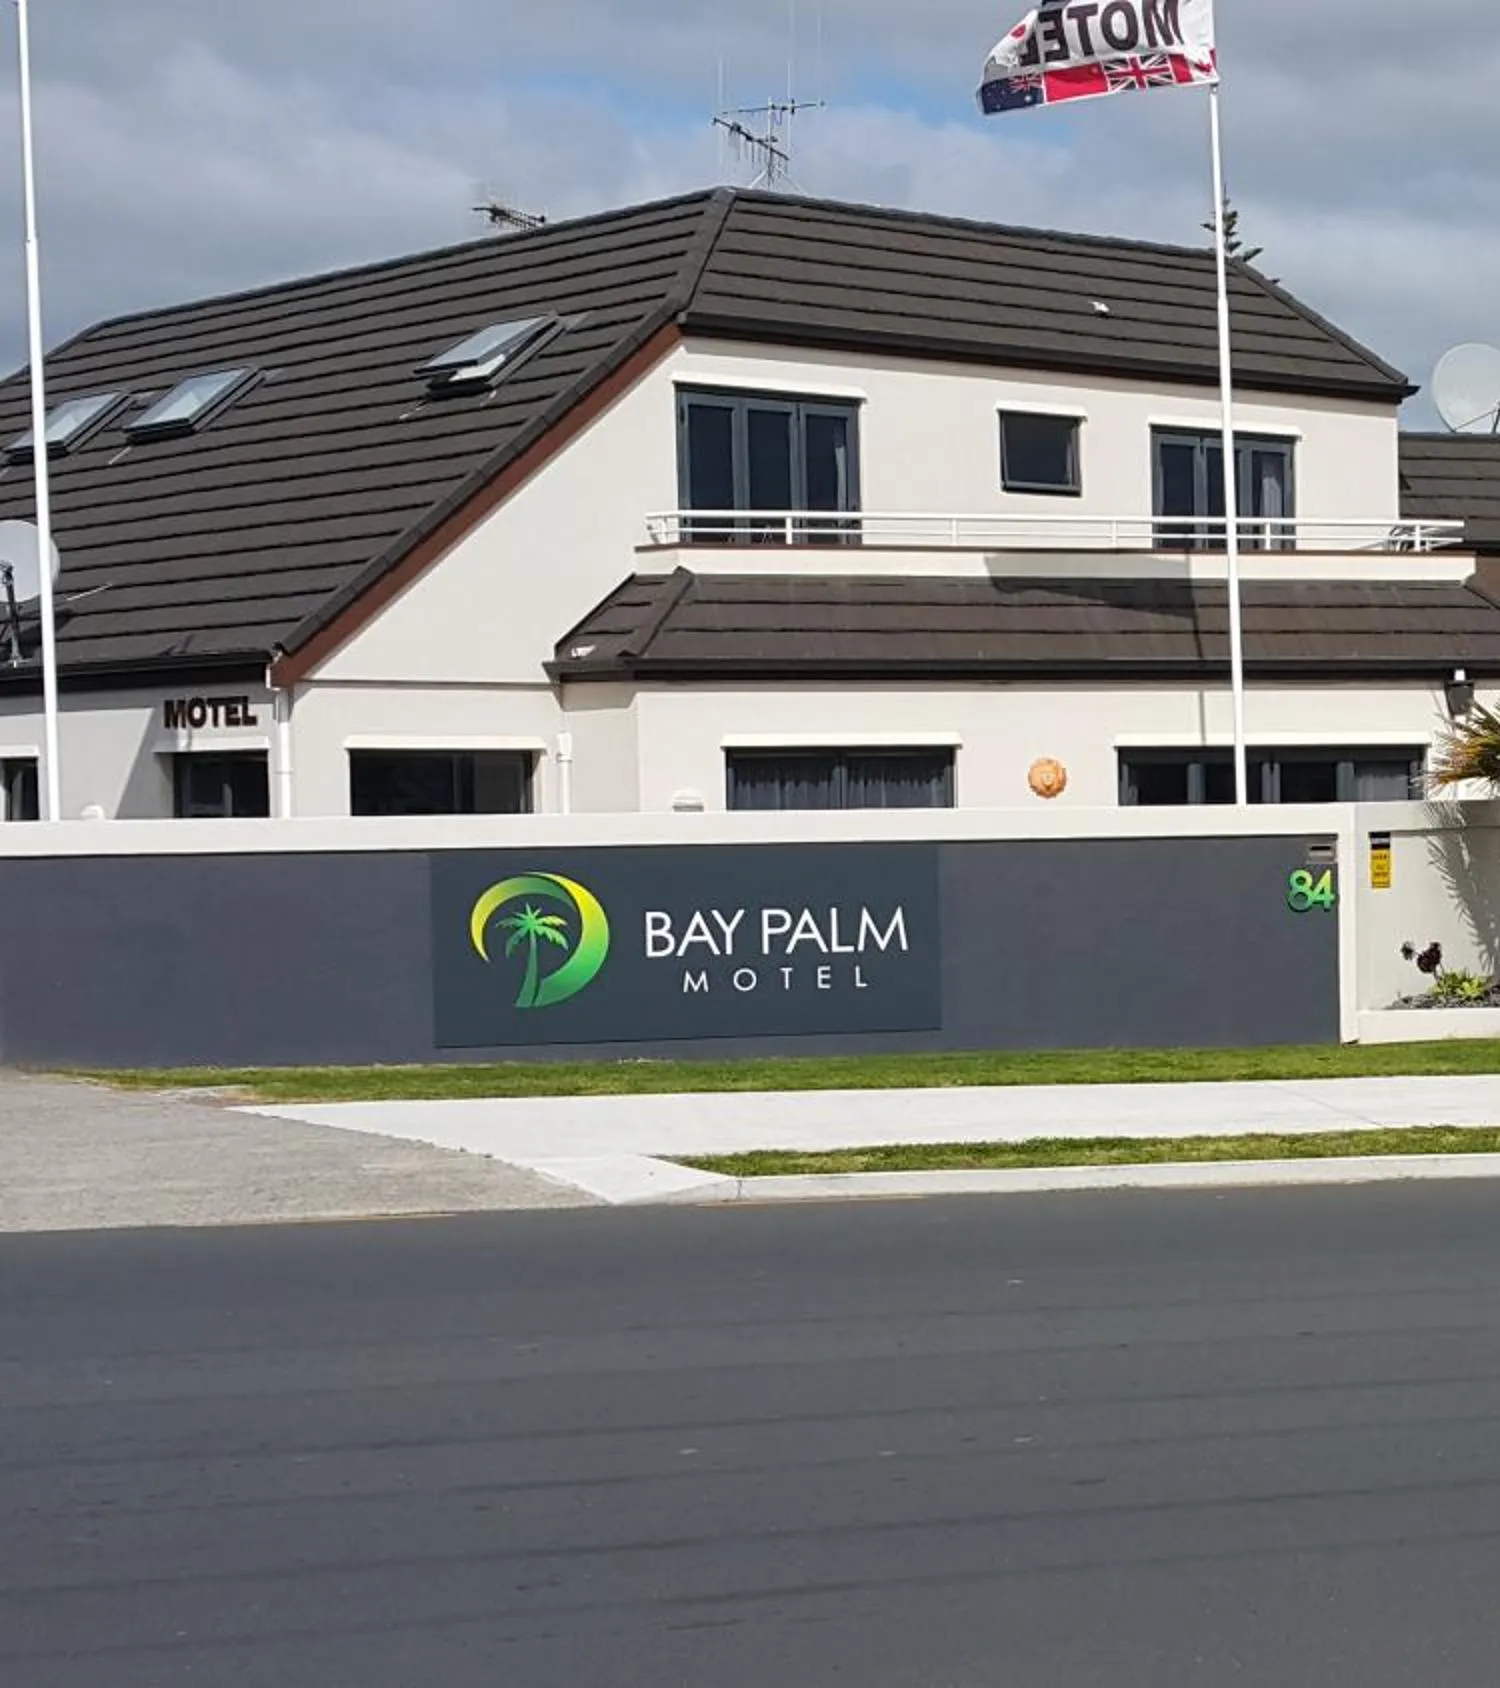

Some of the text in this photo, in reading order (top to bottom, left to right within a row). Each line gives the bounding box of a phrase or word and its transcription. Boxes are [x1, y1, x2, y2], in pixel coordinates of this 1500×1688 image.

[163, 695, 258, 729] MOTEL
[1287, 869, 1336, 912] 84
[645, 905, 909, 958] BAY PALM
[683, 966, 868, 993] MOTEL
